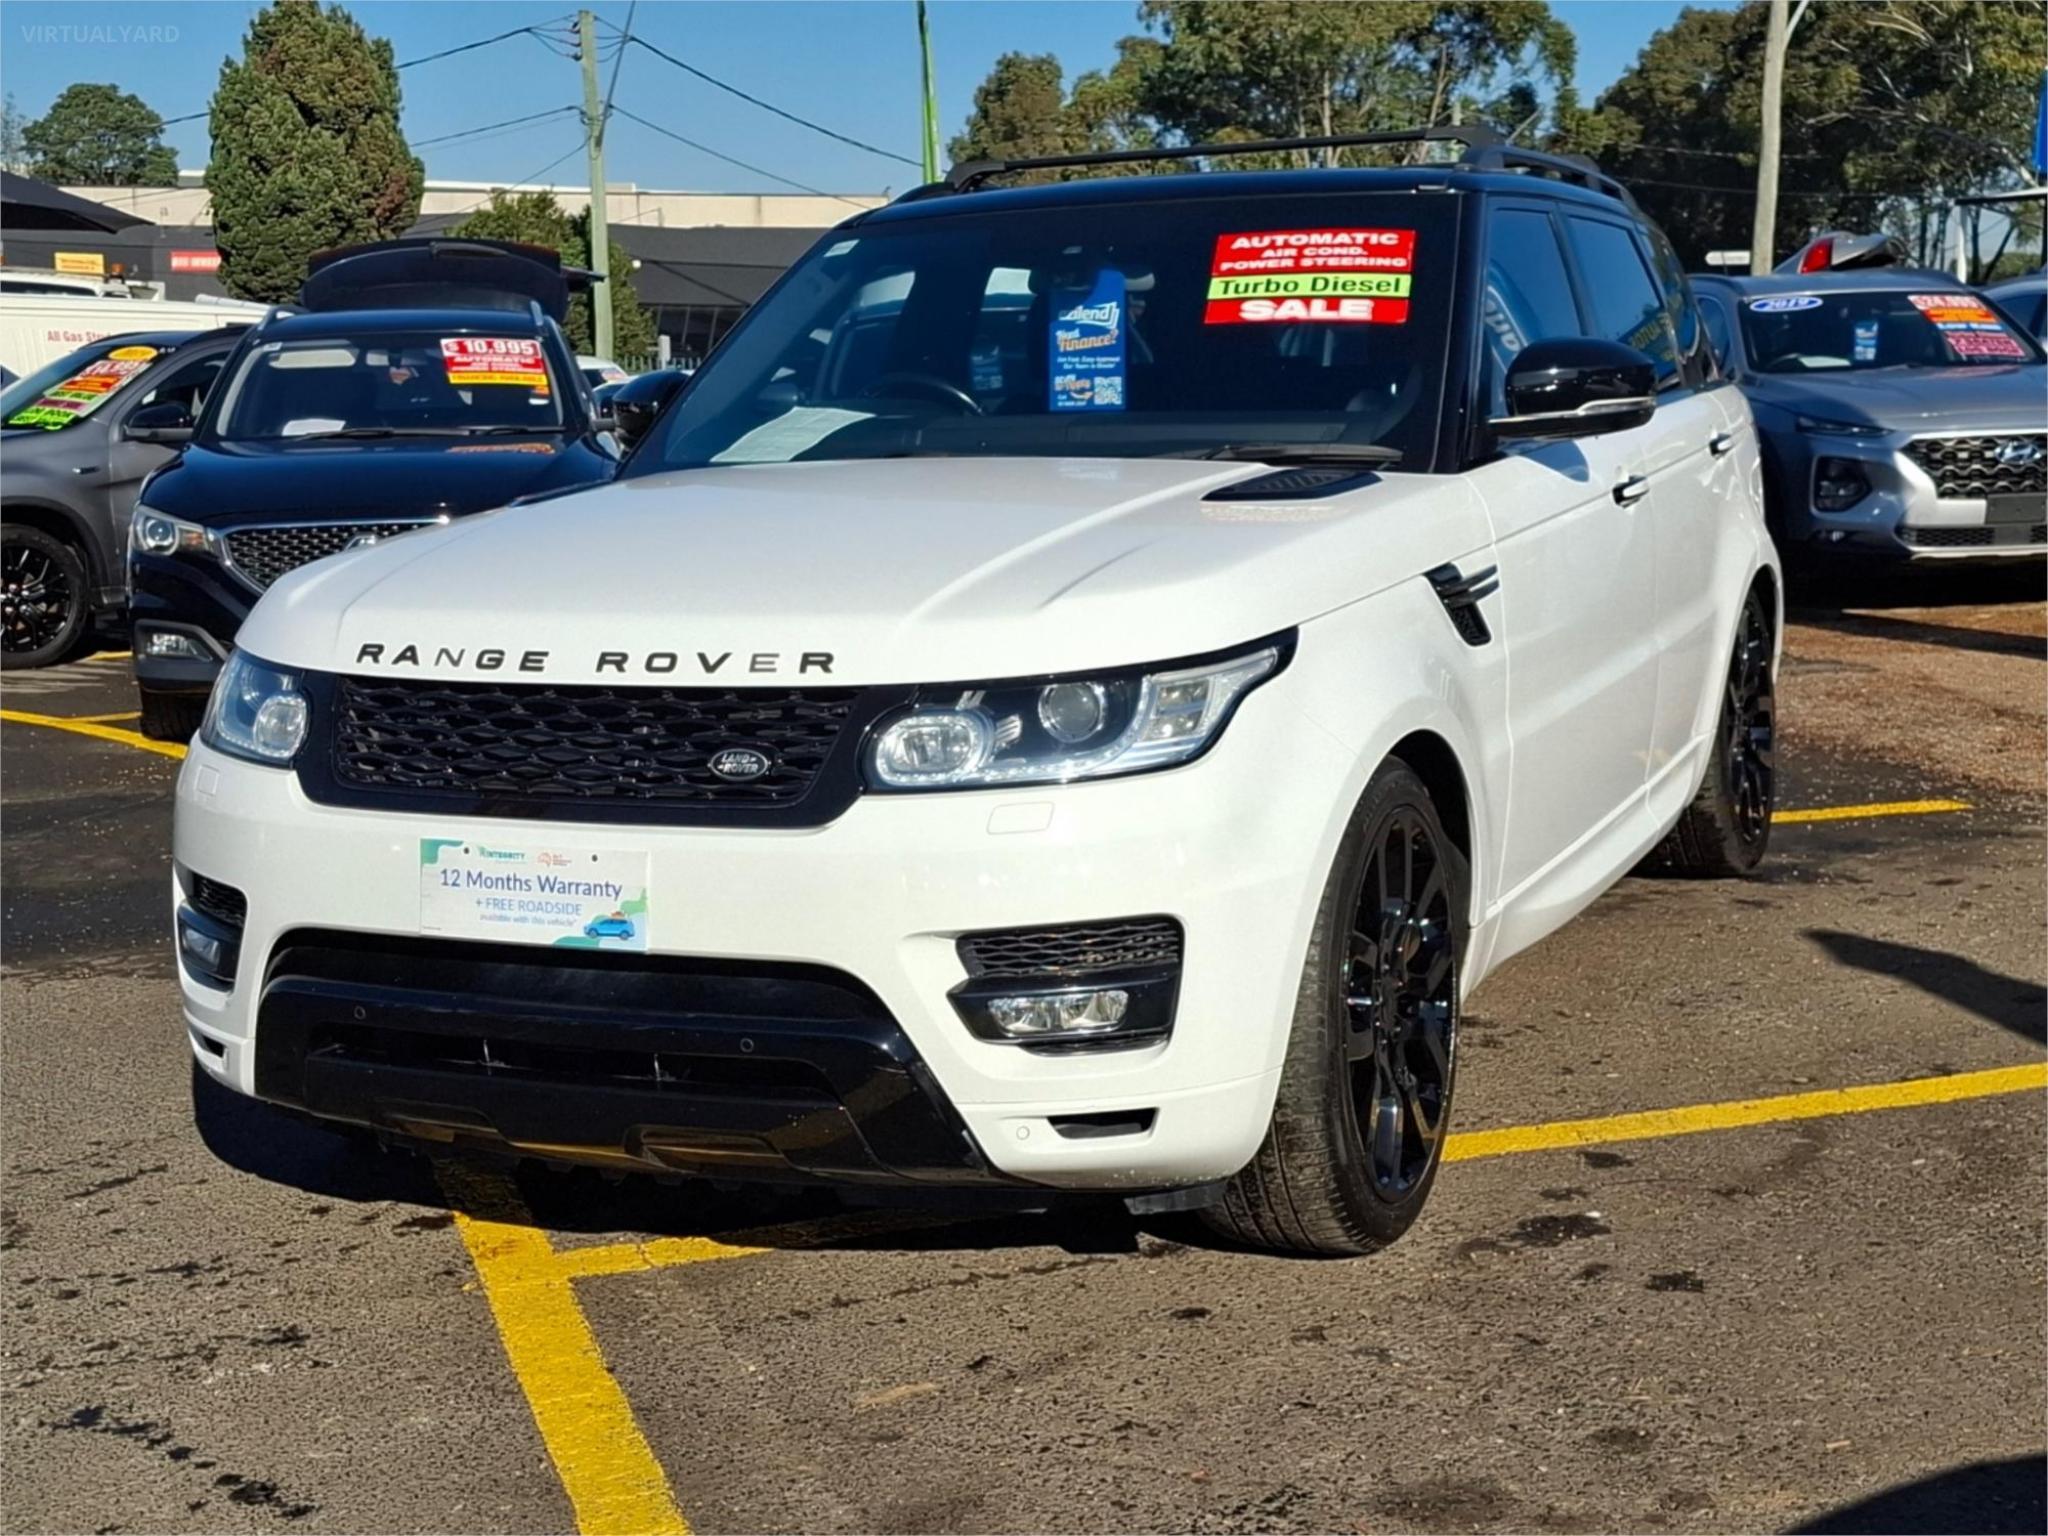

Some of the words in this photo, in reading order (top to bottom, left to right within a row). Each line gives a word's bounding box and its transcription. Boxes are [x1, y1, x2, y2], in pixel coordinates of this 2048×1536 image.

[1231, 233, 1400, 250] AUTOMATIC
[1261, 248, 1297, 258] AIR
[1302, 246, 1368, 256] COND.
[1219, 258, 1295, 271] POWER
[1300, 257, 1408, 267] STEERING
[1219, 278, 1300, 295] Turbo
[1310, 276, 1401, 293] Diesel
[1239, 299, 1375, 321] SALE
[356, 643, 549, 673] RANGE
[595, 651, 834, 674] ROVER
[721, 753, 750, 764] LAND
[440, 868, 461, 887] 12
[466, 870, 533, 892] Months
[537, 874, 623, 901] Warranty
[485, 897, 515, 911] FREE
[518, 901, 583, 916] ROADSIDE
